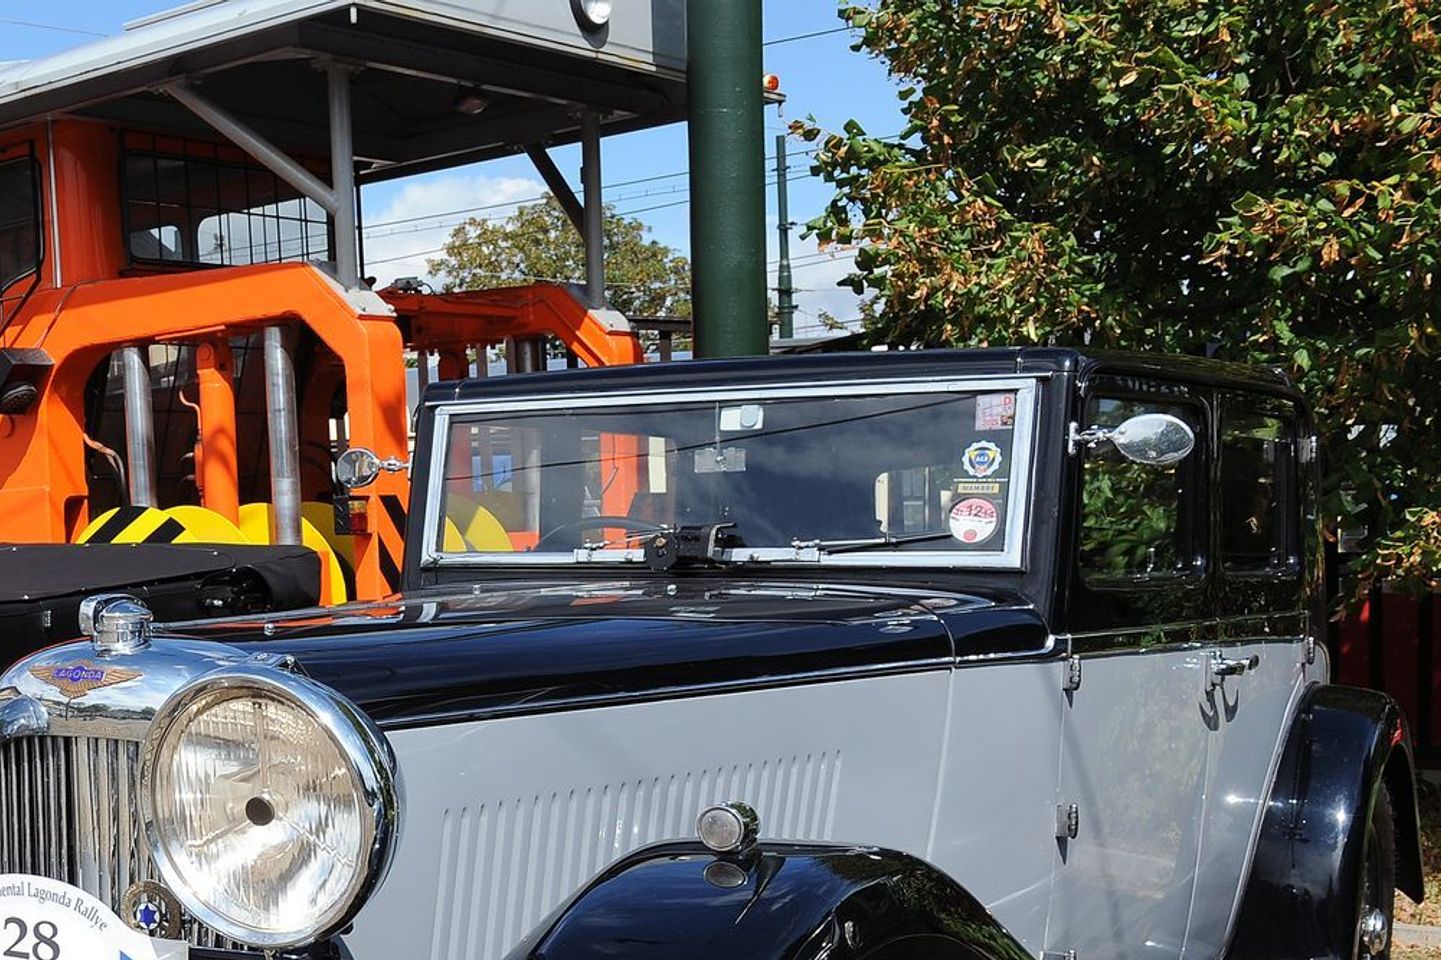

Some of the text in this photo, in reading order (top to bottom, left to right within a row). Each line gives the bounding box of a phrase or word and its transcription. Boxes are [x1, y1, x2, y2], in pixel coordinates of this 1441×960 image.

[52, 668, 103, 681] LAGONDA
[27, 882, 72, 908] Lagonda
[73, 897, 108, 932] Rallye
